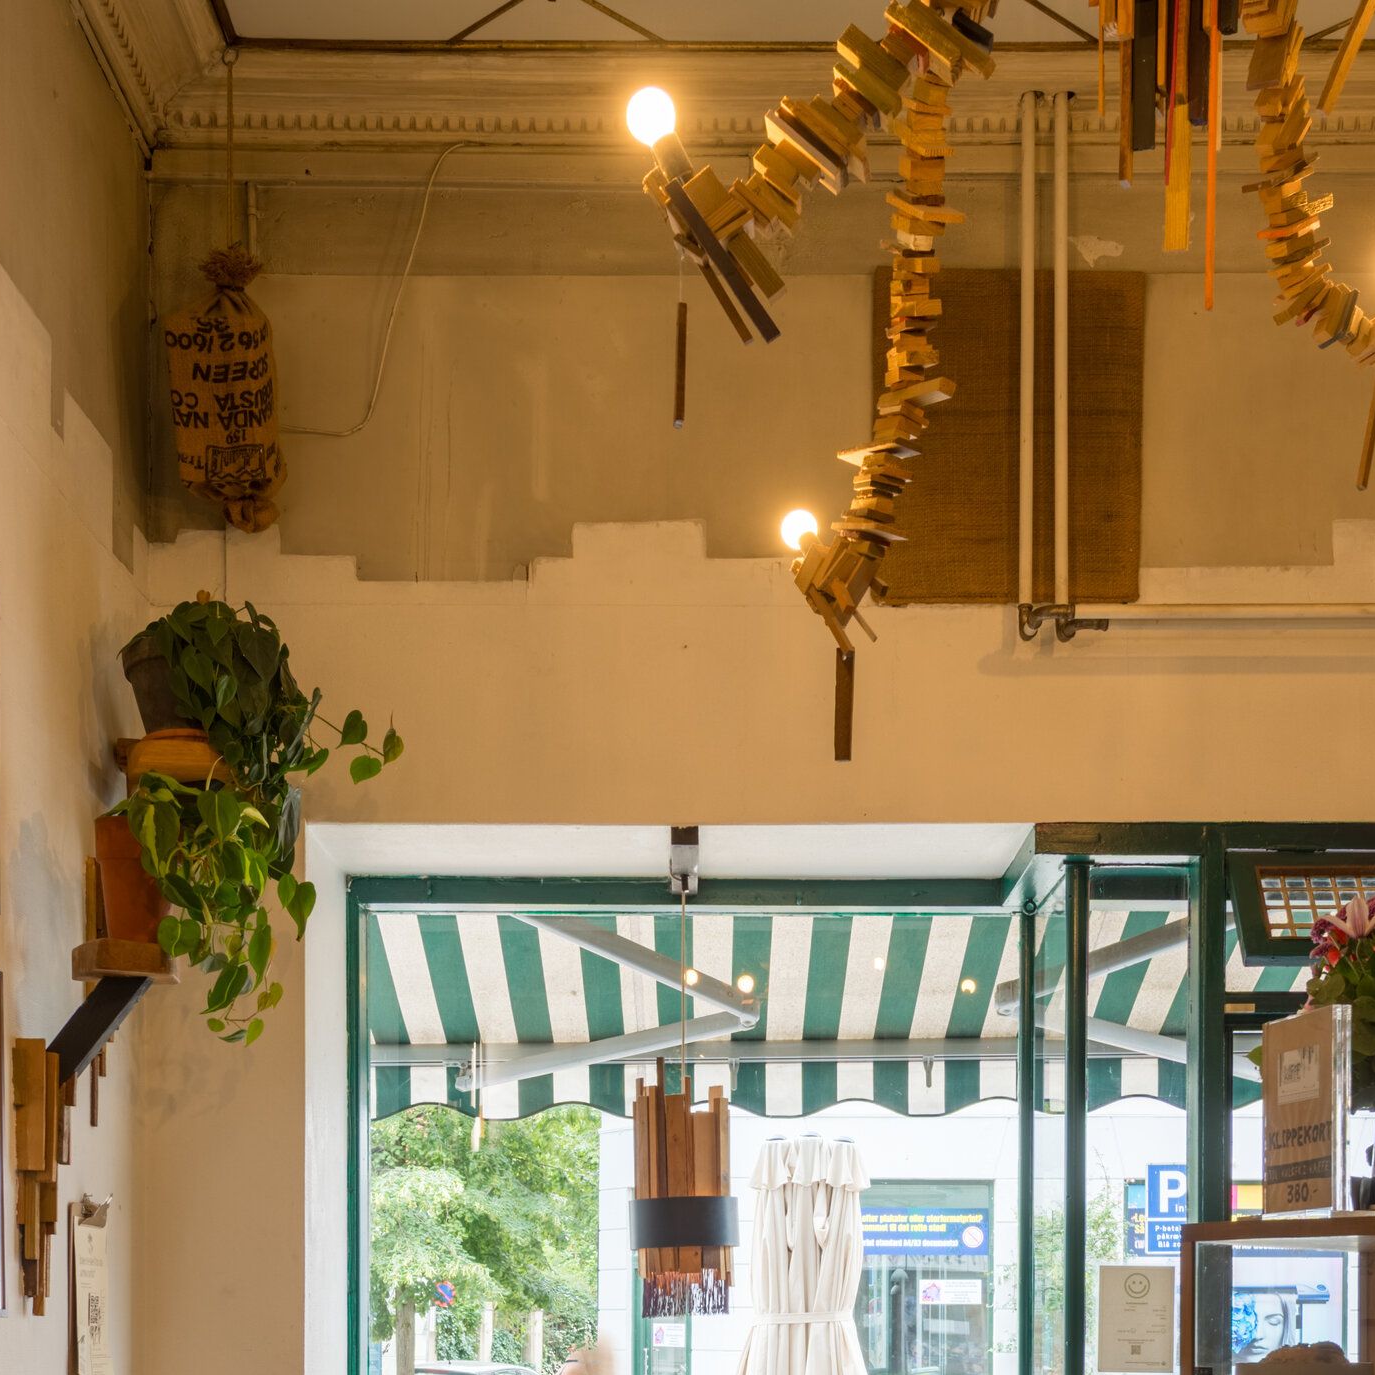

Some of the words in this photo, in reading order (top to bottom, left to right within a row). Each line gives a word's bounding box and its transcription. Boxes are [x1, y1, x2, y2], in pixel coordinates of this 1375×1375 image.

[193, 353, 268, 383] SCREEN
[1268, 1120, 1331, 1150] KLIPPEKORT
[1159, 1170, 1187, 1213] P
